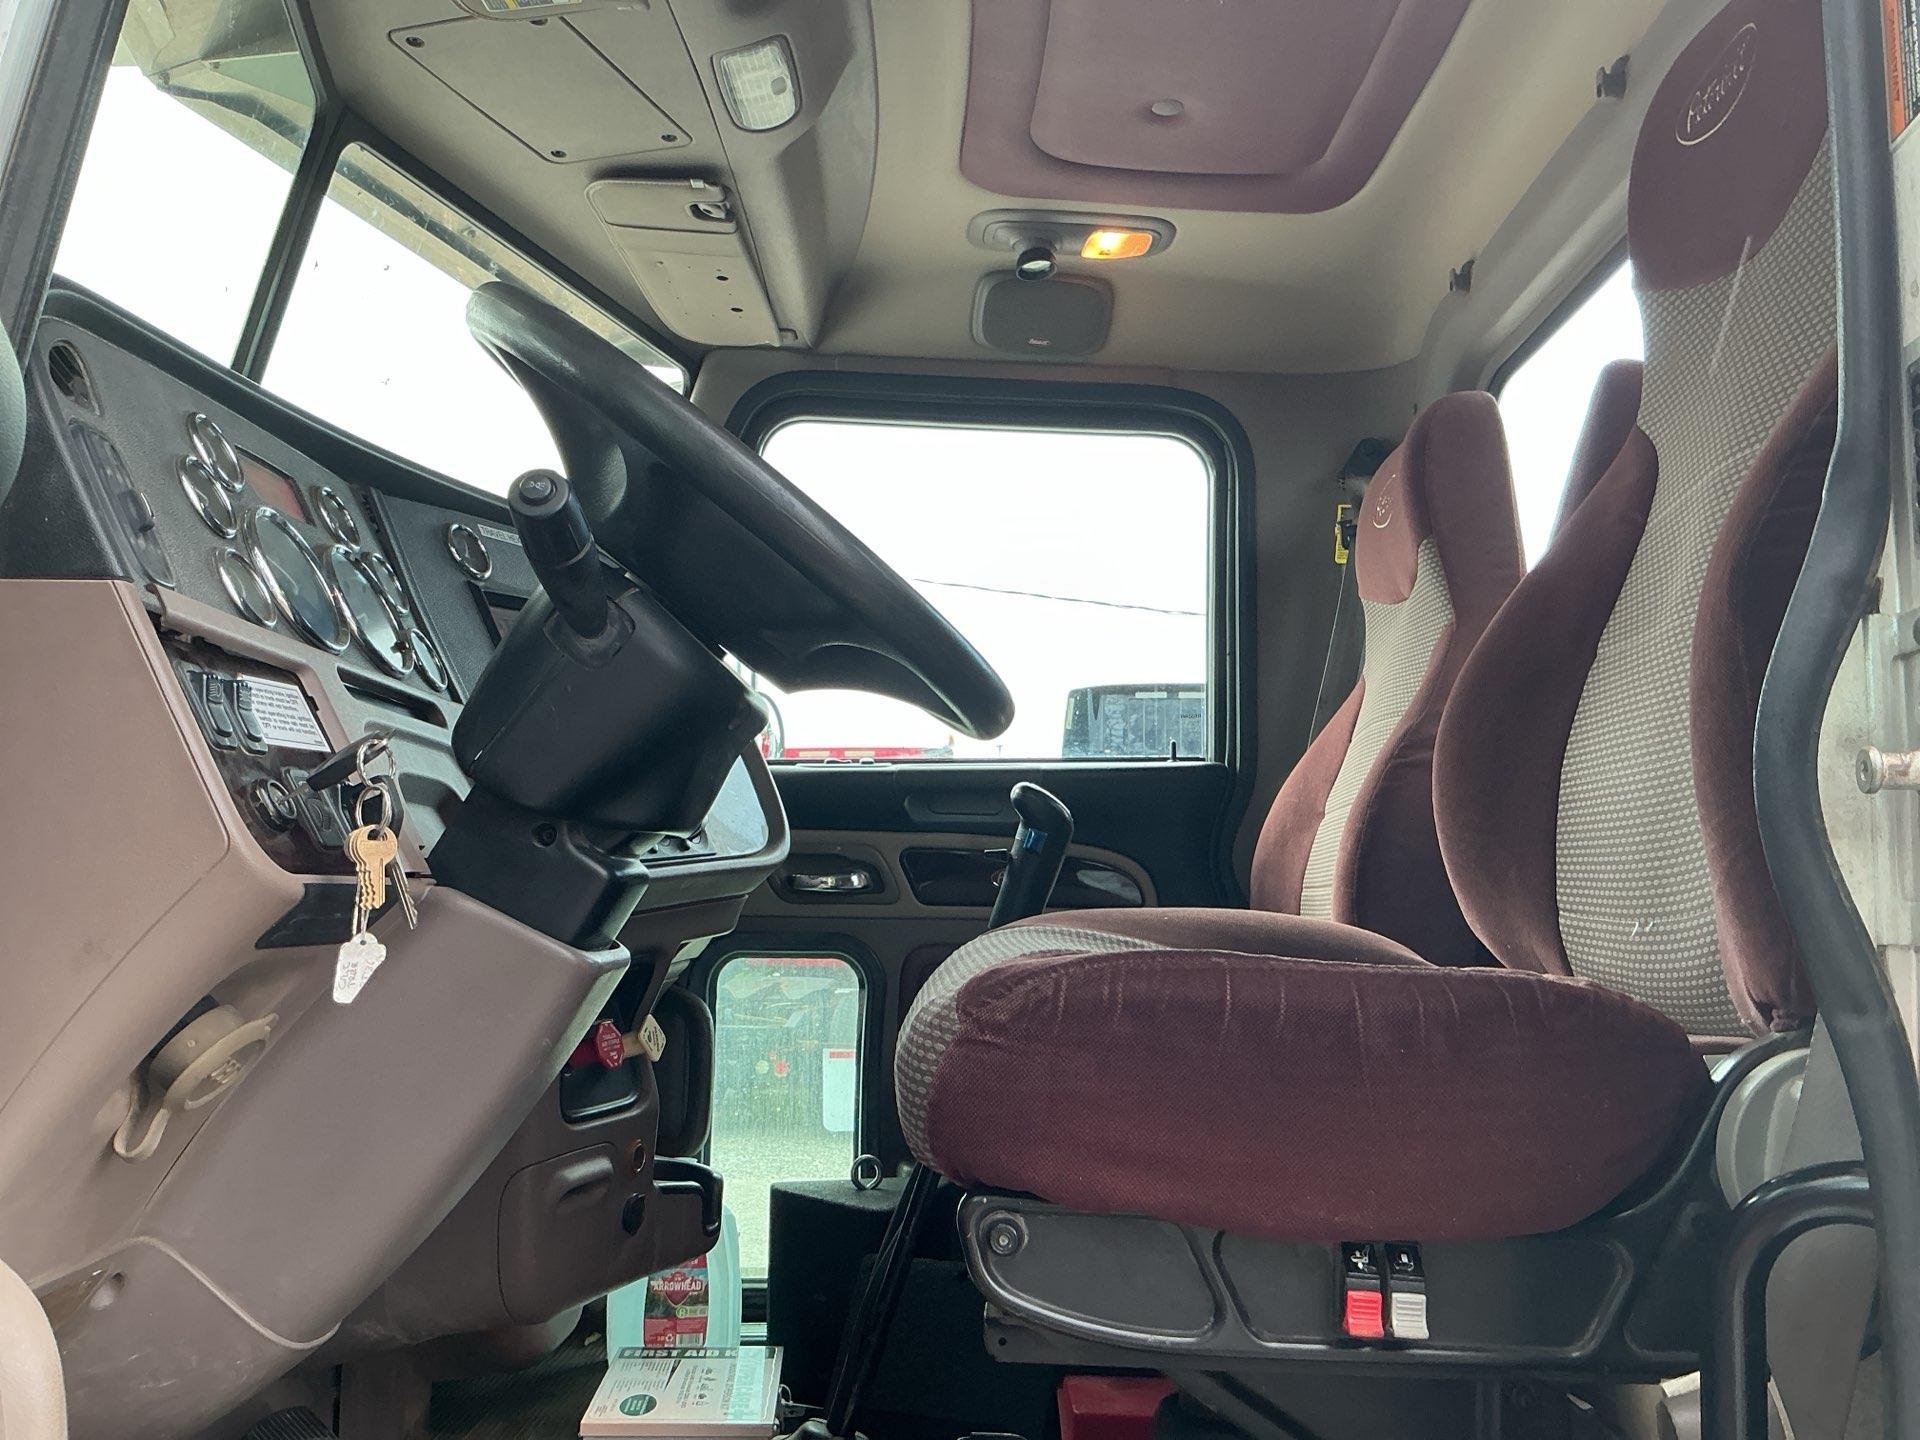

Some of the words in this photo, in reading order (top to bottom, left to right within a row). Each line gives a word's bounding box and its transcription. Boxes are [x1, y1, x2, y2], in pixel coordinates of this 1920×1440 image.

[651, 1277, 702, 1291] ARROWHEAD
[623, 1349, 680, 1358] FIRST
[684, 1349, 719, 1358] AID
